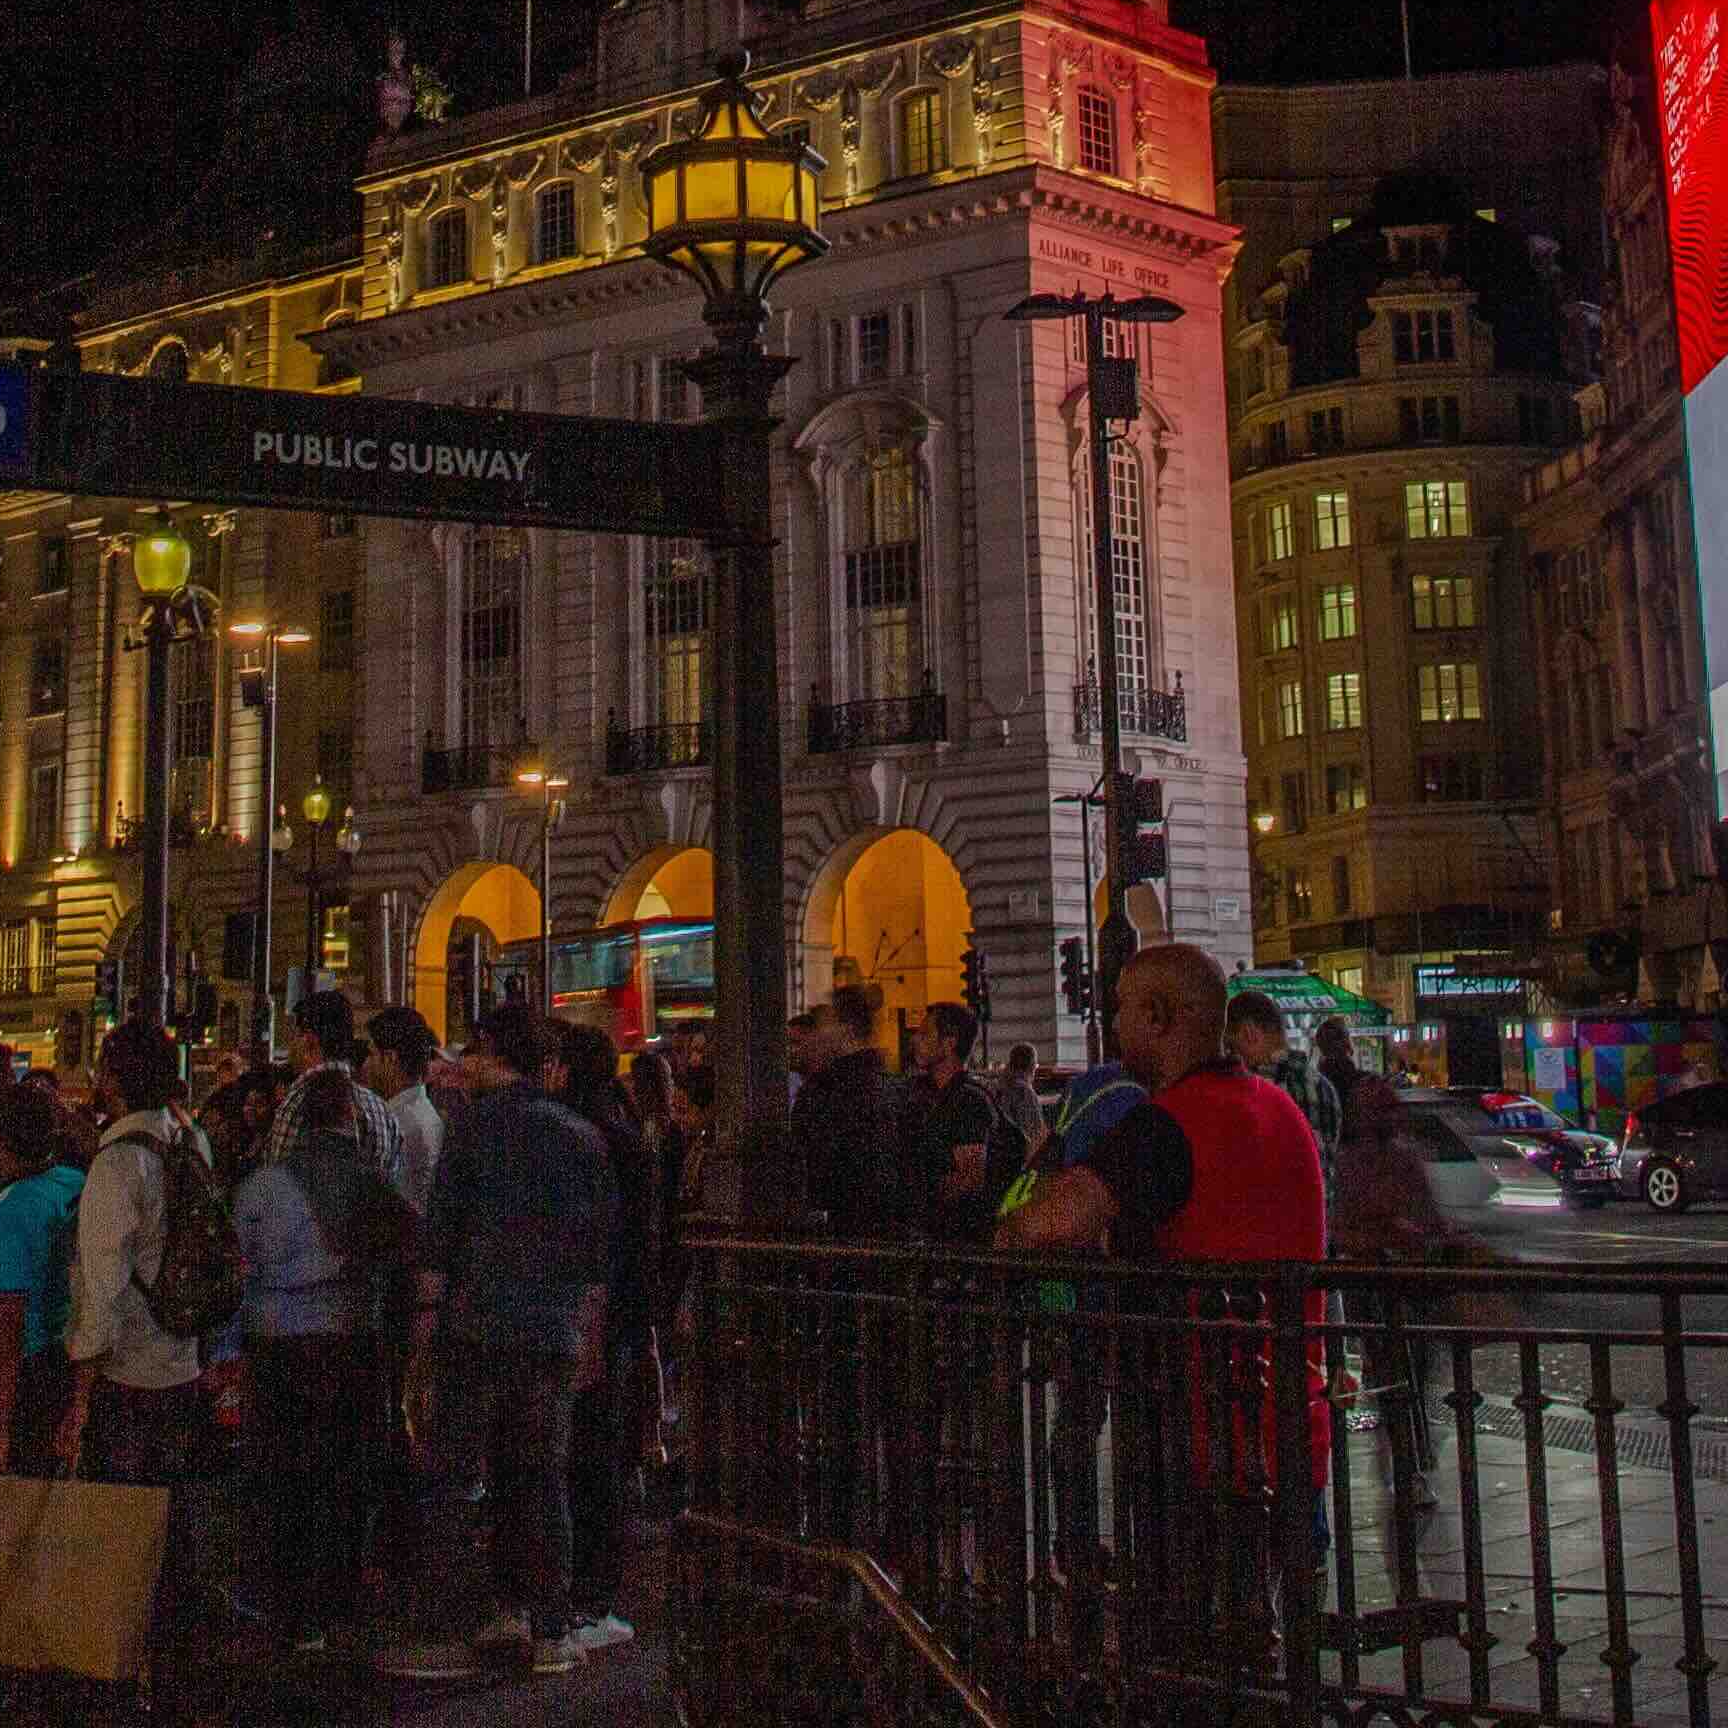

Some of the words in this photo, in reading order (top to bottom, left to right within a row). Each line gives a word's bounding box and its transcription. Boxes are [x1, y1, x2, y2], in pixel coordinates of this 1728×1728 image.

[1039, 239, 1091, 267] ALLIANCE
[1102, 257, 1125, 277] LIFE
[1134, 266, 1169, 289] OFFICE
[253, 431, 378, 471] PUBLIC
[388, 441, 532, 481] SUBWAY
